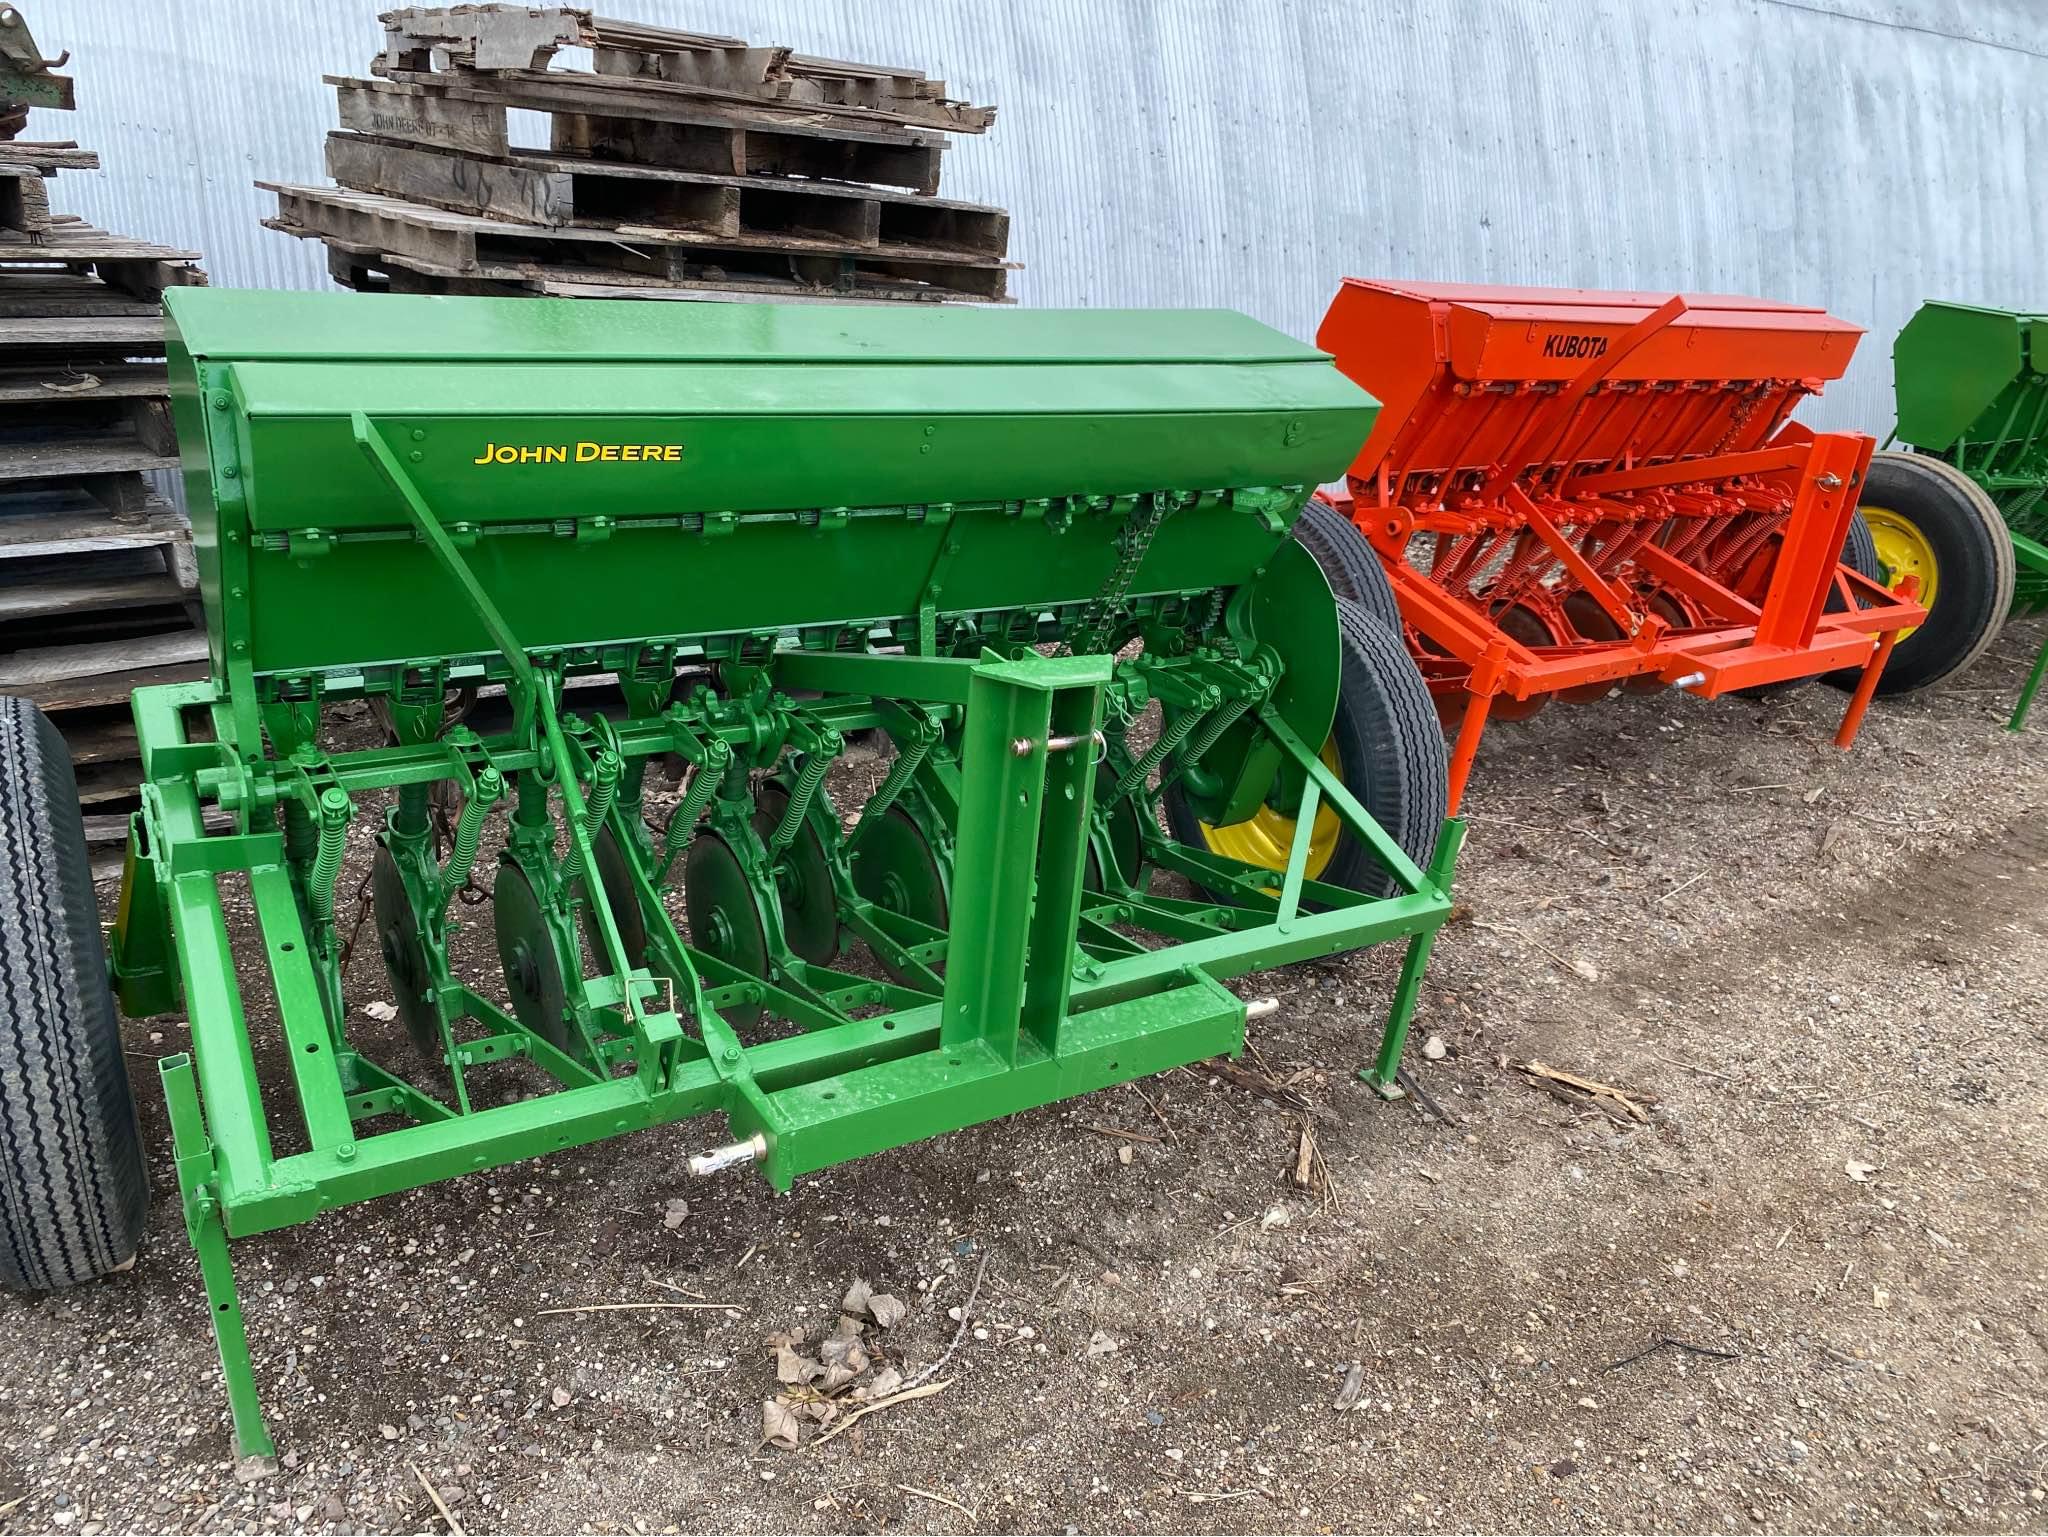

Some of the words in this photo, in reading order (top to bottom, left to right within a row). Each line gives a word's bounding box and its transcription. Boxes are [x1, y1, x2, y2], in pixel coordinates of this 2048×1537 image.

[1542, 334, 1608, 358] KUBOTA
[474, 442, 568, 465] JOHN
[574, 441, 684, 463] DEERE
